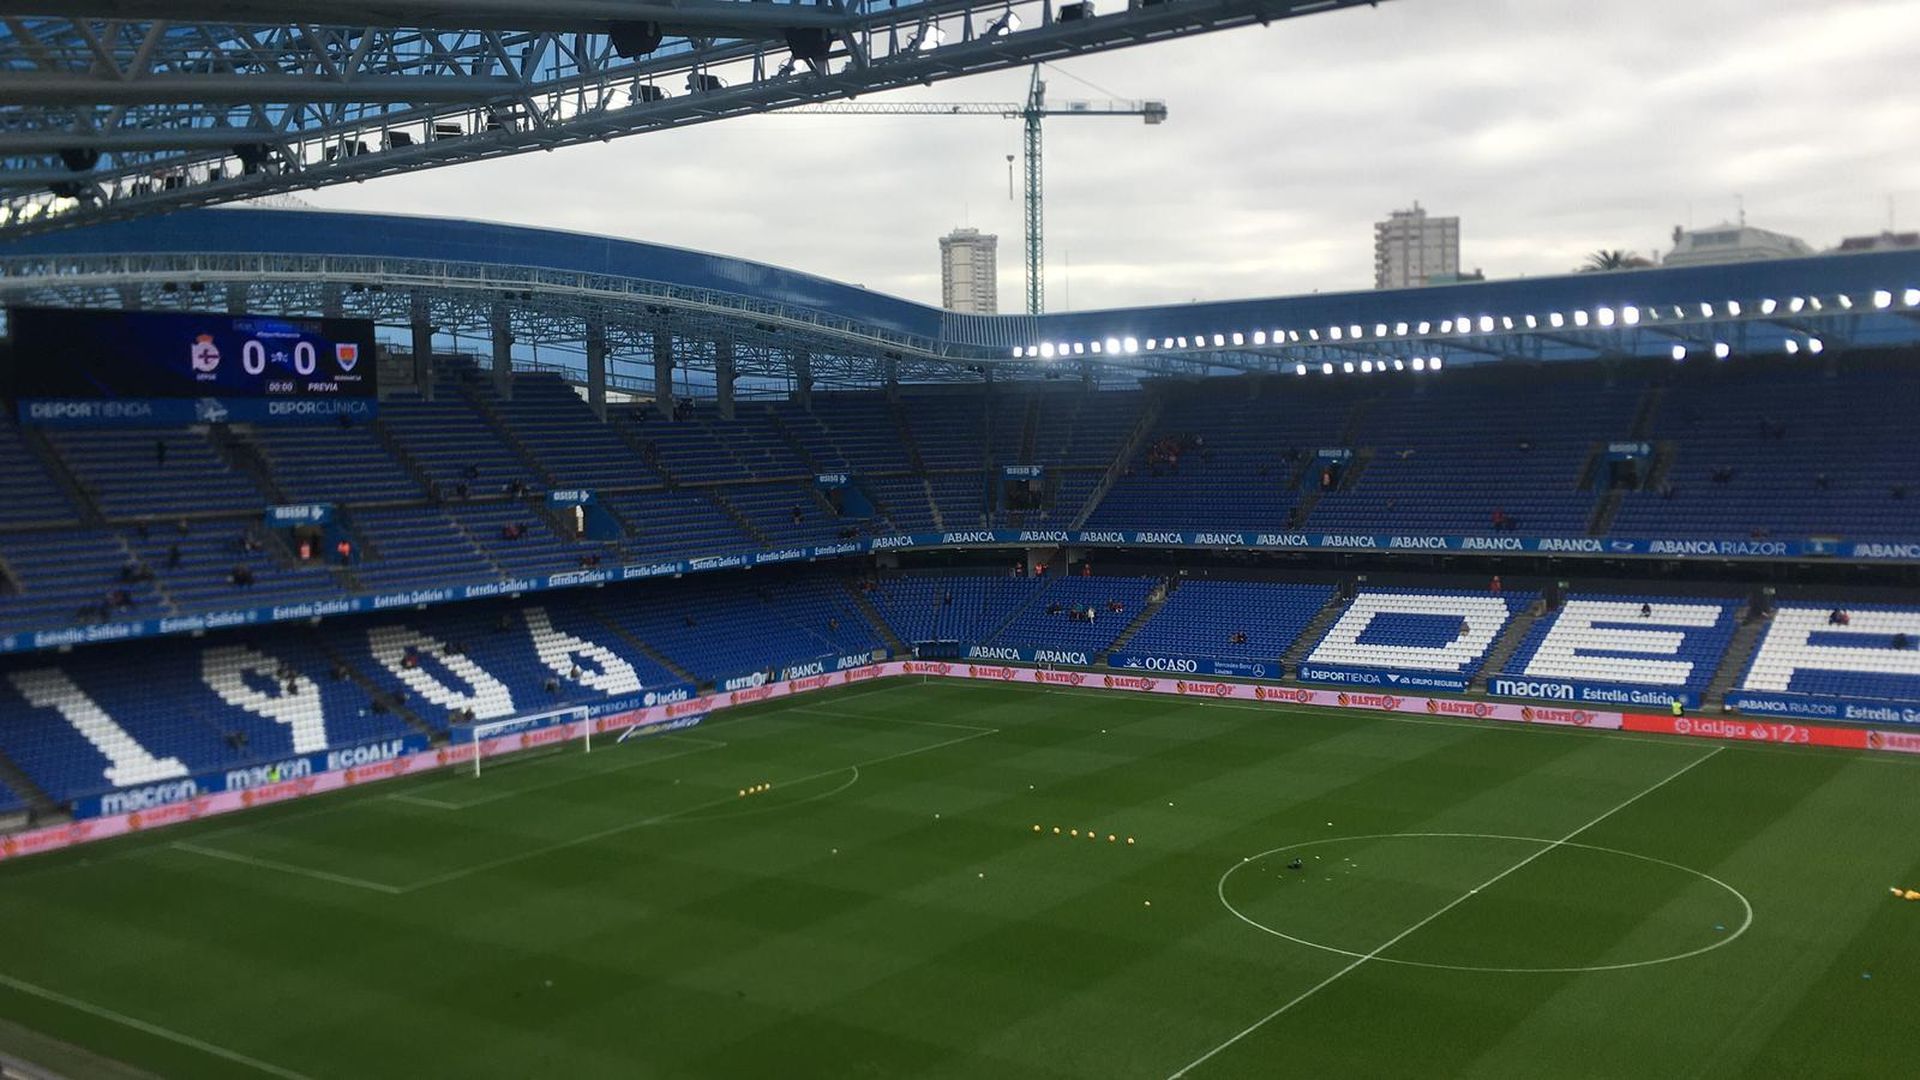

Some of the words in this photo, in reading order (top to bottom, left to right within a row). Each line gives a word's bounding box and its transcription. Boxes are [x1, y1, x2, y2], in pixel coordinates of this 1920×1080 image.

[243, 340, 265, 375] 0
[294, 341, 316, 375] 0
[269, 382, 293, 392] 00:00
[308, 382, 338, 392] PREVIA
[875, 535, 914, 548] ABANCA
[948, 531, 995, 544] ABANCA
[1025, 531, 1069, 542] ABANCA
[1084, 532, 1125, 543] ABANCA
[1140, 532, 1183, 543] ABANCA
[1200, 533, 1244, 545] ABANCA
[1261, 534, 1308, 546] ABANCA
[1327, 535, 1376, 548] ABANCA
[1396, 536, 1447, 549] ABANCA
[1467, 537, 1523, 550] ABANCA
[1545, 538, 1603, 552] ABANCA
[1721, 542, 1786, 556] RIAZOR
[974, 646, 1020, 660] ABANCA
[1040, 650, 1087, 664] ABANCA
[1146, 657, 1198, 673] OCASO
[1311, 670, 1381, 684] DEPORTIENDA
[656, 688, 688, 704] luckia
[1496, 679, 1574, 699] macron
[1583, 687, 1629, 703] Estrella
[1631, 690, 1674, 705] Galicia
[1845, 705, 1900, 721] Estrella
[1693, 719, 1746, 737] LaLiga
[327, 739, 403, 770] ECOALF
[103, 779, 197, 815] macron
